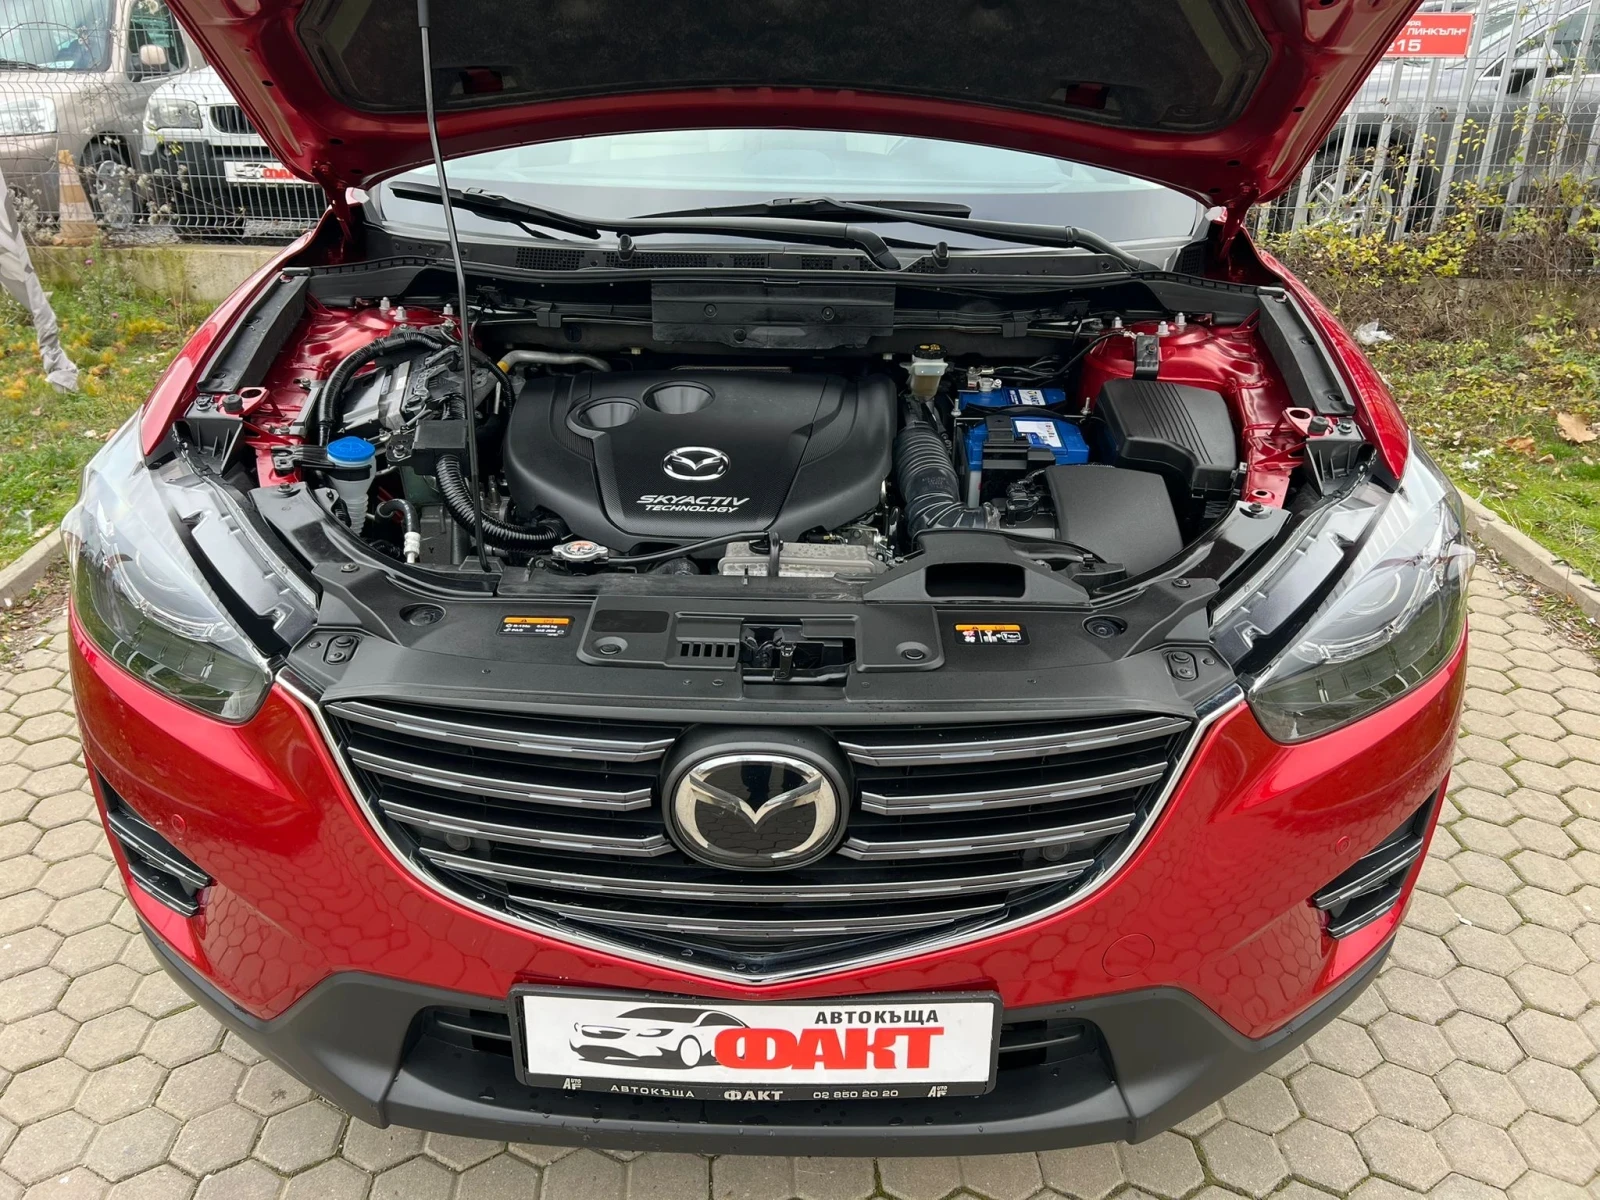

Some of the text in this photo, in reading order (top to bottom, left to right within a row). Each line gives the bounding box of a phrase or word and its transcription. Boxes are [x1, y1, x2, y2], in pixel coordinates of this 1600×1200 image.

[636, 494, 750, 506] SKYACTIV
[645, 504, 739, 513] TECHNOLOGY
[815, 1009, 938, 1025] АВТОКЪЩА
[714, 1027, 944, 1069] ФАКТ
[723, 1089, 783, 1101] ФАКТ
[813, 1091, 830, 1099] 02
[833, 1091, 858, 1099] 850
[862, 1090, 879, 1098] 20
[882, 1090, 899, 1098] 20
